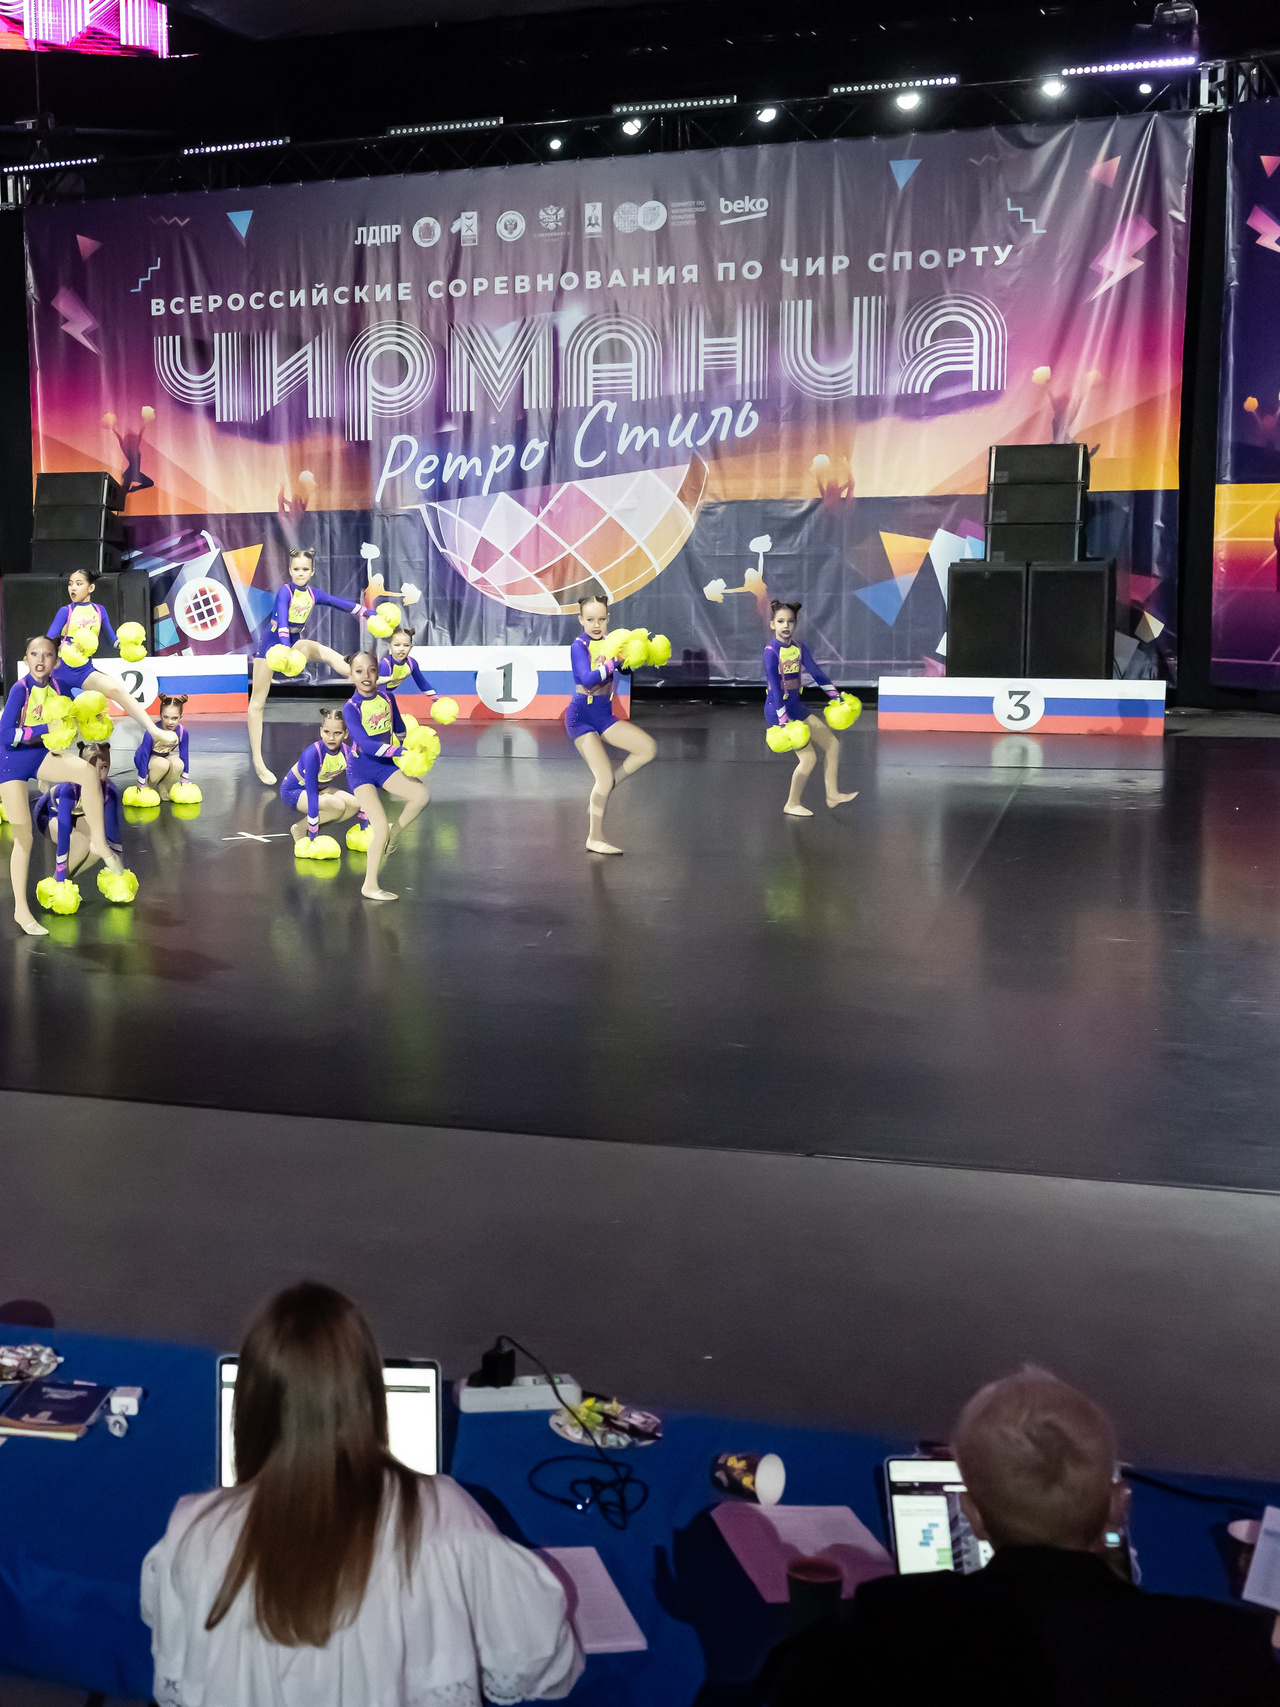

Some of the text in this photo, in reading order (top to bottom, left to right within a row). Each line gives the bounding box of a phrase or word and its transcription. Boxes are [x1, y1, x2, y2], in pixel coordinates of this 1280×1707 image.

[720, 195, 769, 214] beko
[354, 225, 402, 247] ЛДПР
[150, 244, 1014, 316] ВСЕРОССИЙСКИЕ СОРЕВНОВАНИЯ ПО ЧИР СПОРТУ
[375, 399, 760, 503] Ретро Стиль
[120, 670, 145, 703] 2
[496, 662, 518, 702] 1
[1007, 690, 1031, 721] 3
